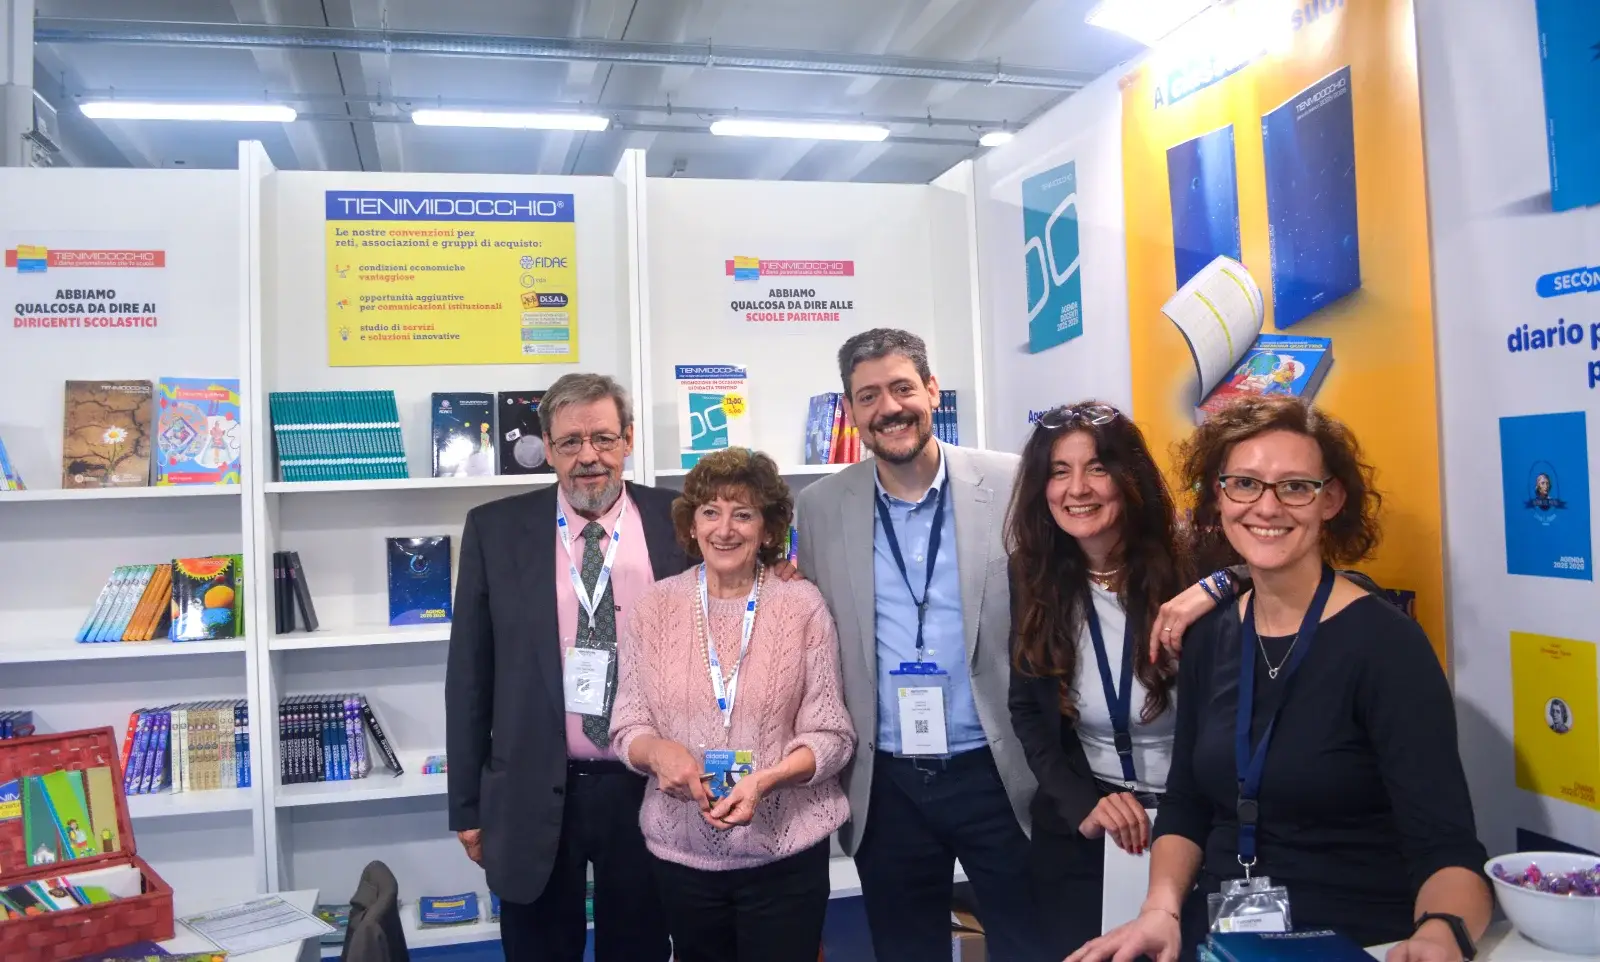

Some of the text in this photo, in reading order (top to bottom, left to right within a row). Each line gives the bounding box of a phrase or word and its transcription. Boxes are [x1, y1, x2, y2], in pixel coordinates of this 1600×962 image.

[336, 228, 475, 239] Le nostre convenzioni per
[336, 238, 359, 248] reti,
[361, 238, 430, 247] associazioni
[441, 239, 478, 249] gruppi
[480, 239, 492, 247] di
[494, 240, 542, 249] acquisto:
[535, 257, 568, 268] FIDAE
[359, 274, 415, 282] vantaggiose
[55, 289, 116, 299] ABBIAMO
[359, 294, 465, 302] opportunità aggiuntive
[768, 289, 816, 298] ABBIAMO
[15, 303, 156, 316] QUALCOSA DA DIRE AI
[360, 304, 376, 312] per
[731, 301, 853, 312] QUALCOSA DA DIRE ALLE
[13, 317, 157, 328] DIRIGENTI SCOLASTICI
[745, 313, 840, 322] SCUOLE PARITARIE
[368, 333, 411, 341] soluzioni
[1507, 318, 1584, 353] diario
